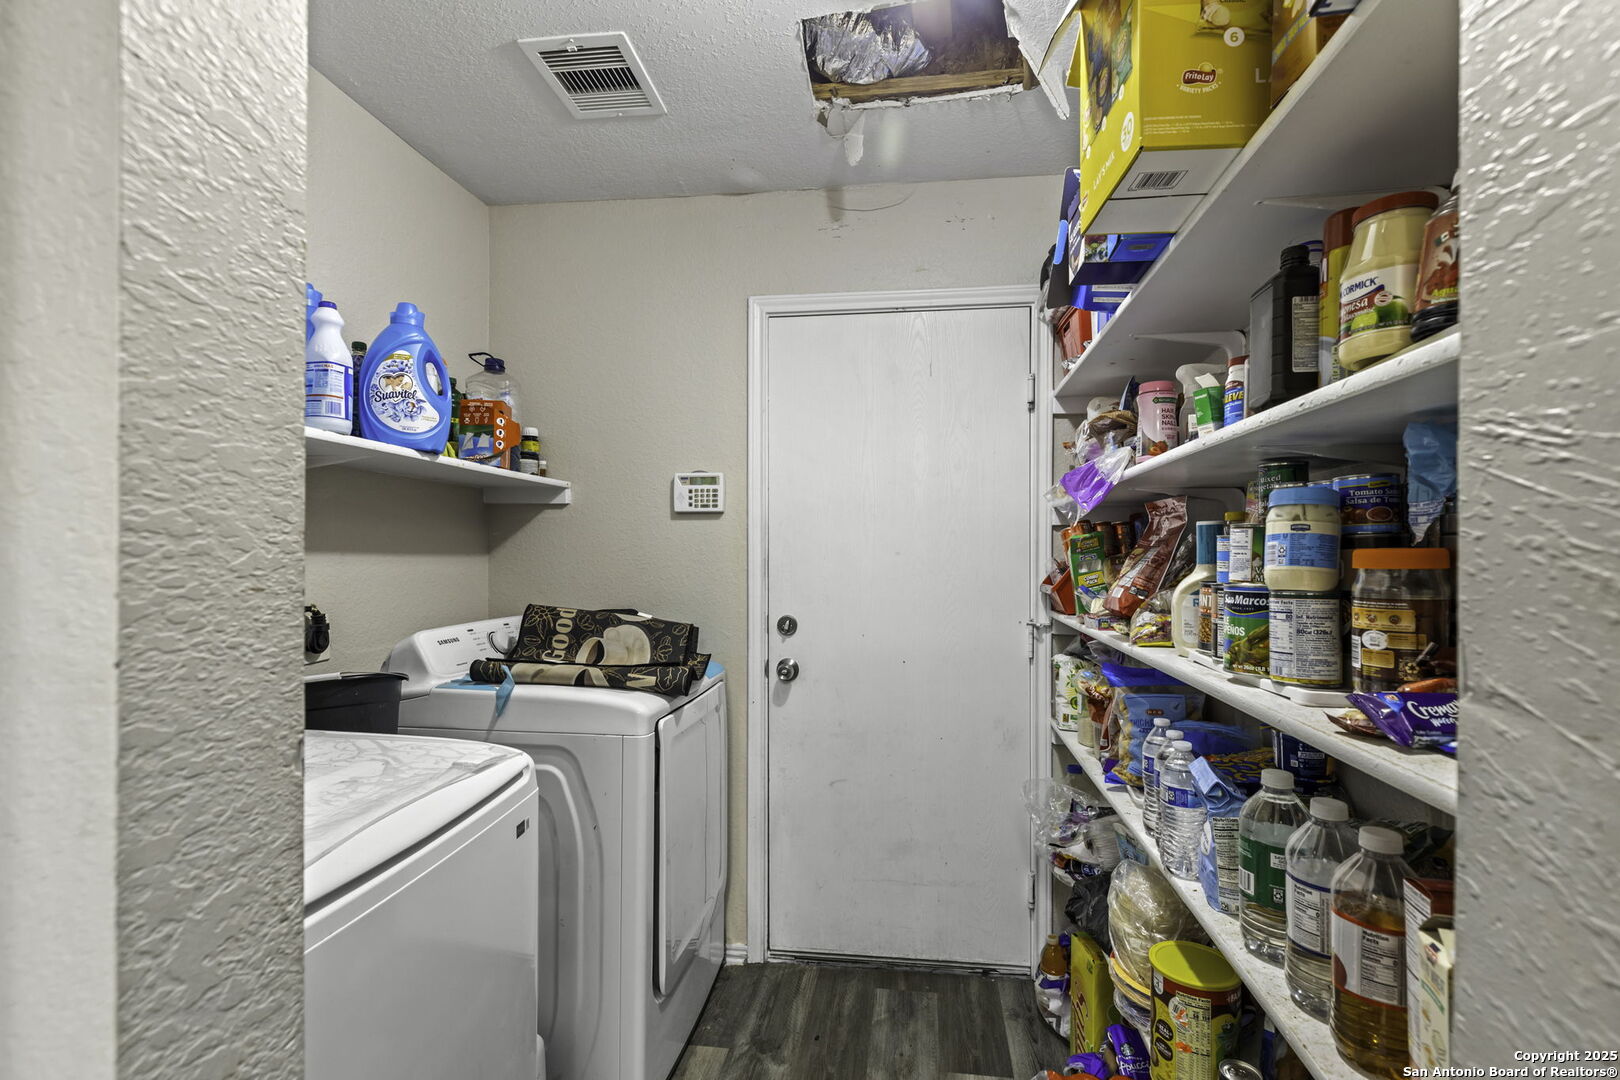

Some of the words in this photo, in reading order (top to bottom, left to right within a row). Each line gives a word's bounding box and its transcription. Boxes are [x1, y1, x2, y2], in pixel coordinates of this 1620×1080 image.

[1230, 31, 1239, 43] 6
[374, 389, 418, 402] Suavitel
[1349, 488, 1383, 497] Tomato
[1370, 496, 1381, 504] de
[541, 608, 578, 662] Good
[437, 636, 460, 646] SAMSUNG
